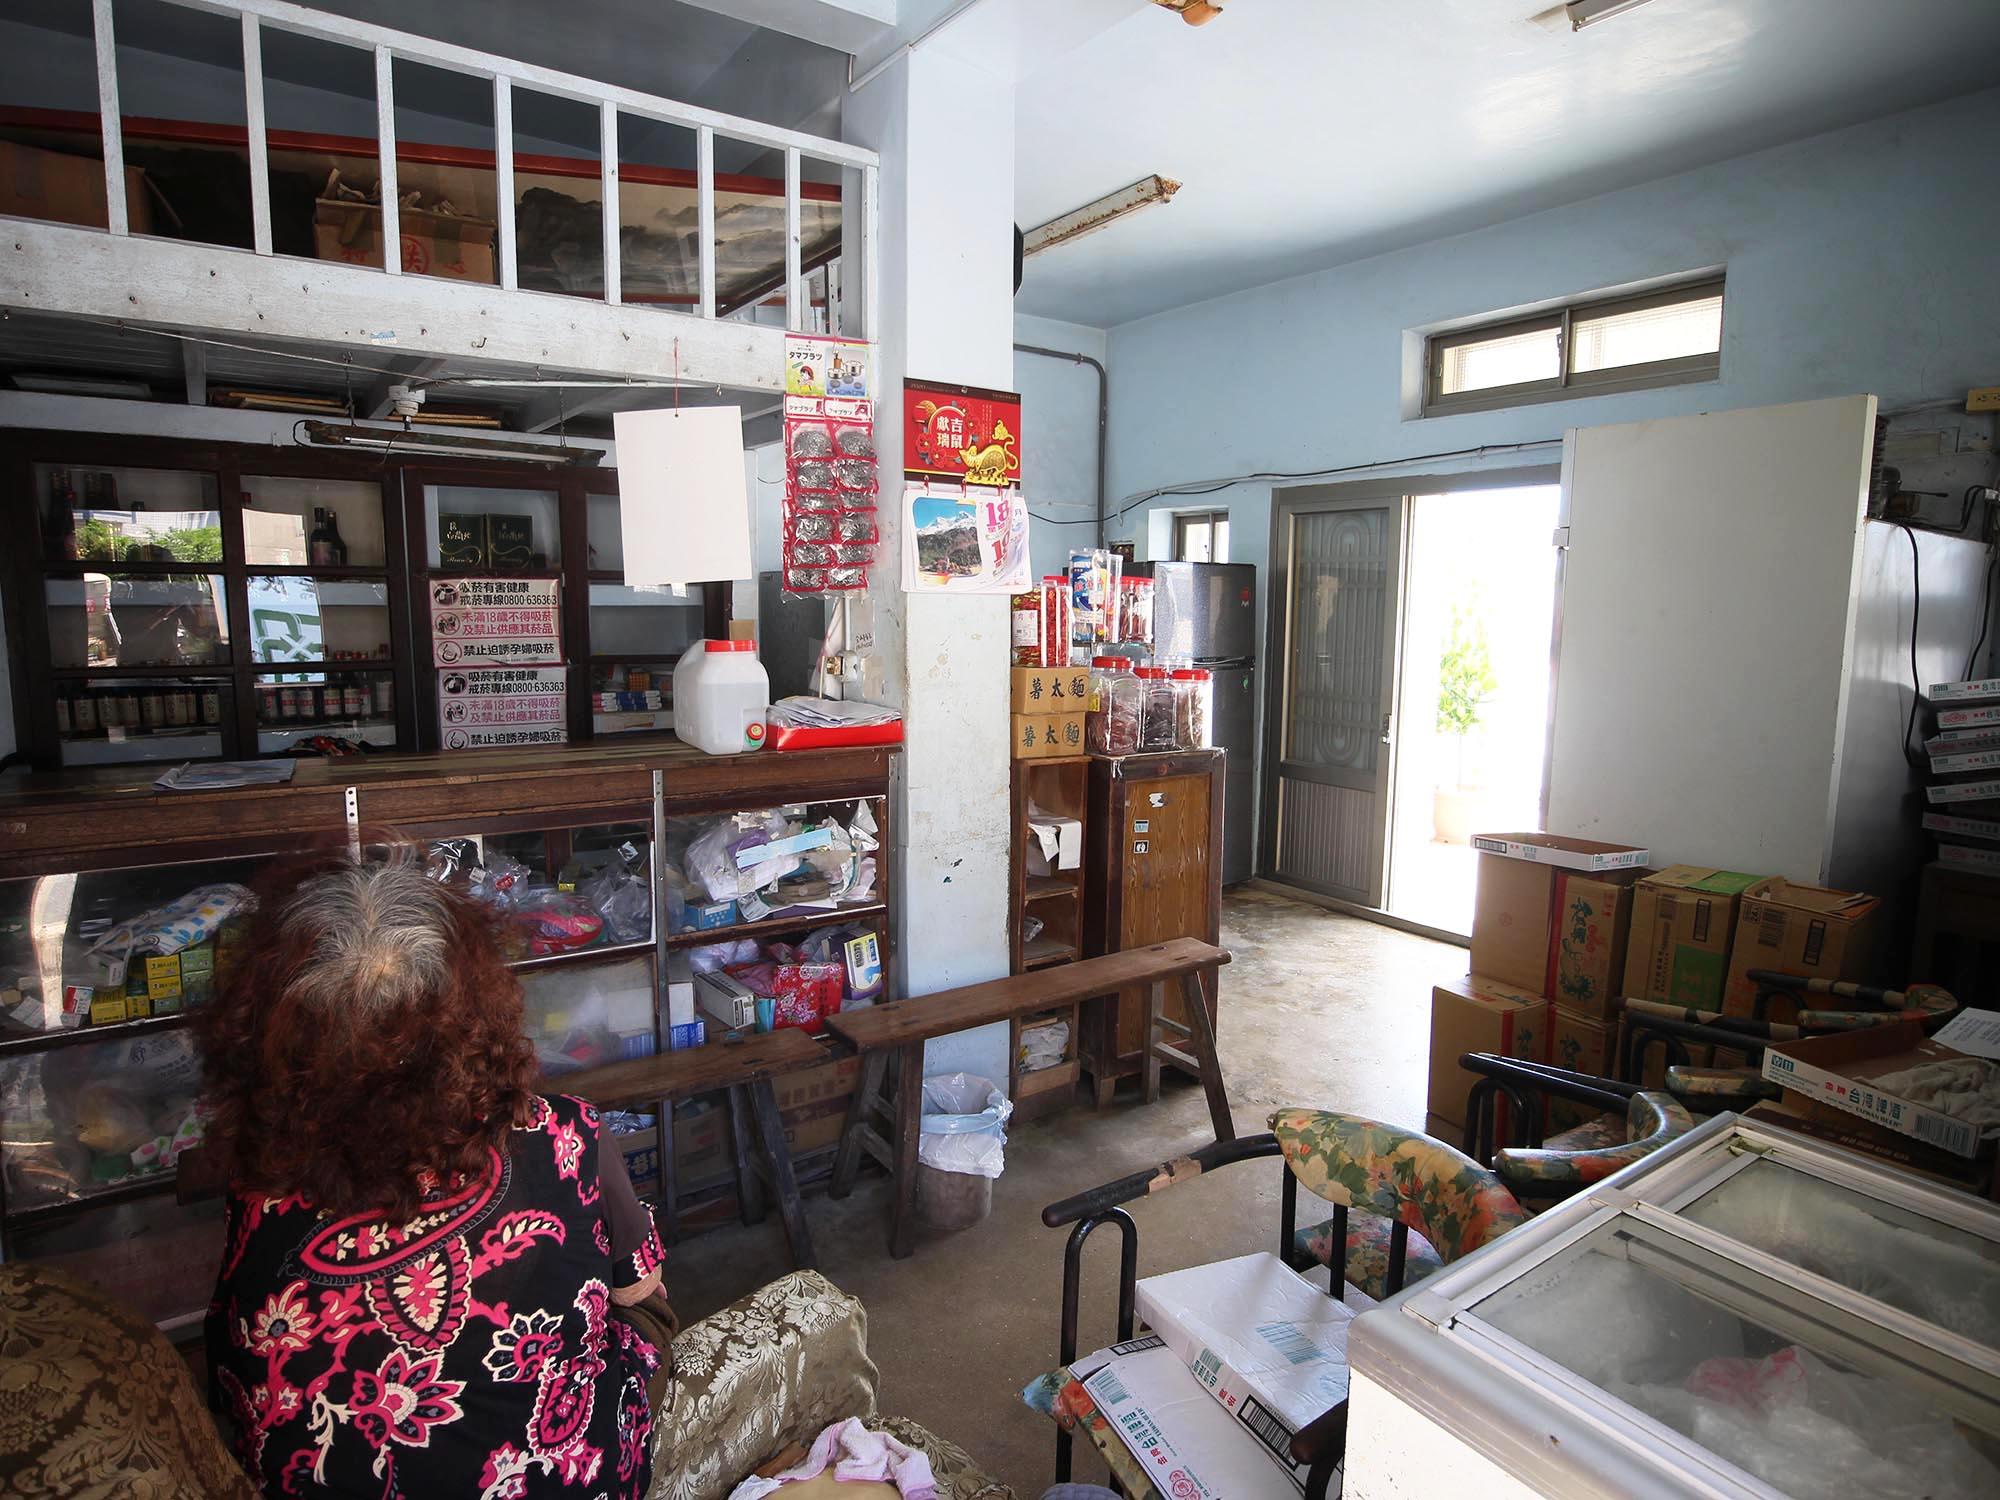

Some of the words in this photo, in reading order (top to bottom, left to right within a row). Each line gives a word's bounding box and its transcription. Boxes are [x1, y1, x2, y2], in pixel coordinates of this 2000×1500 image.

[986, 500, 1010, 527] 18
[459, 581, 530, 594] 吸菸有害健康
[461, 610, 553, 623] 未滿18歲不得吸菸
[462, 623, 554, 636] 及禁止供應其菸品
[463, 643, 555, 657] 禁止迫誘孕婦吸菸
[468, 670, 539, 683] 吸菸有害健康
[469, 697, 561, 711] 未滿18歲不得吸菸
[470, 709, 560, 723] 及禁止供應其菸品
[470, 730, 562, 746] 禁止迫誘孕婦吸菸
